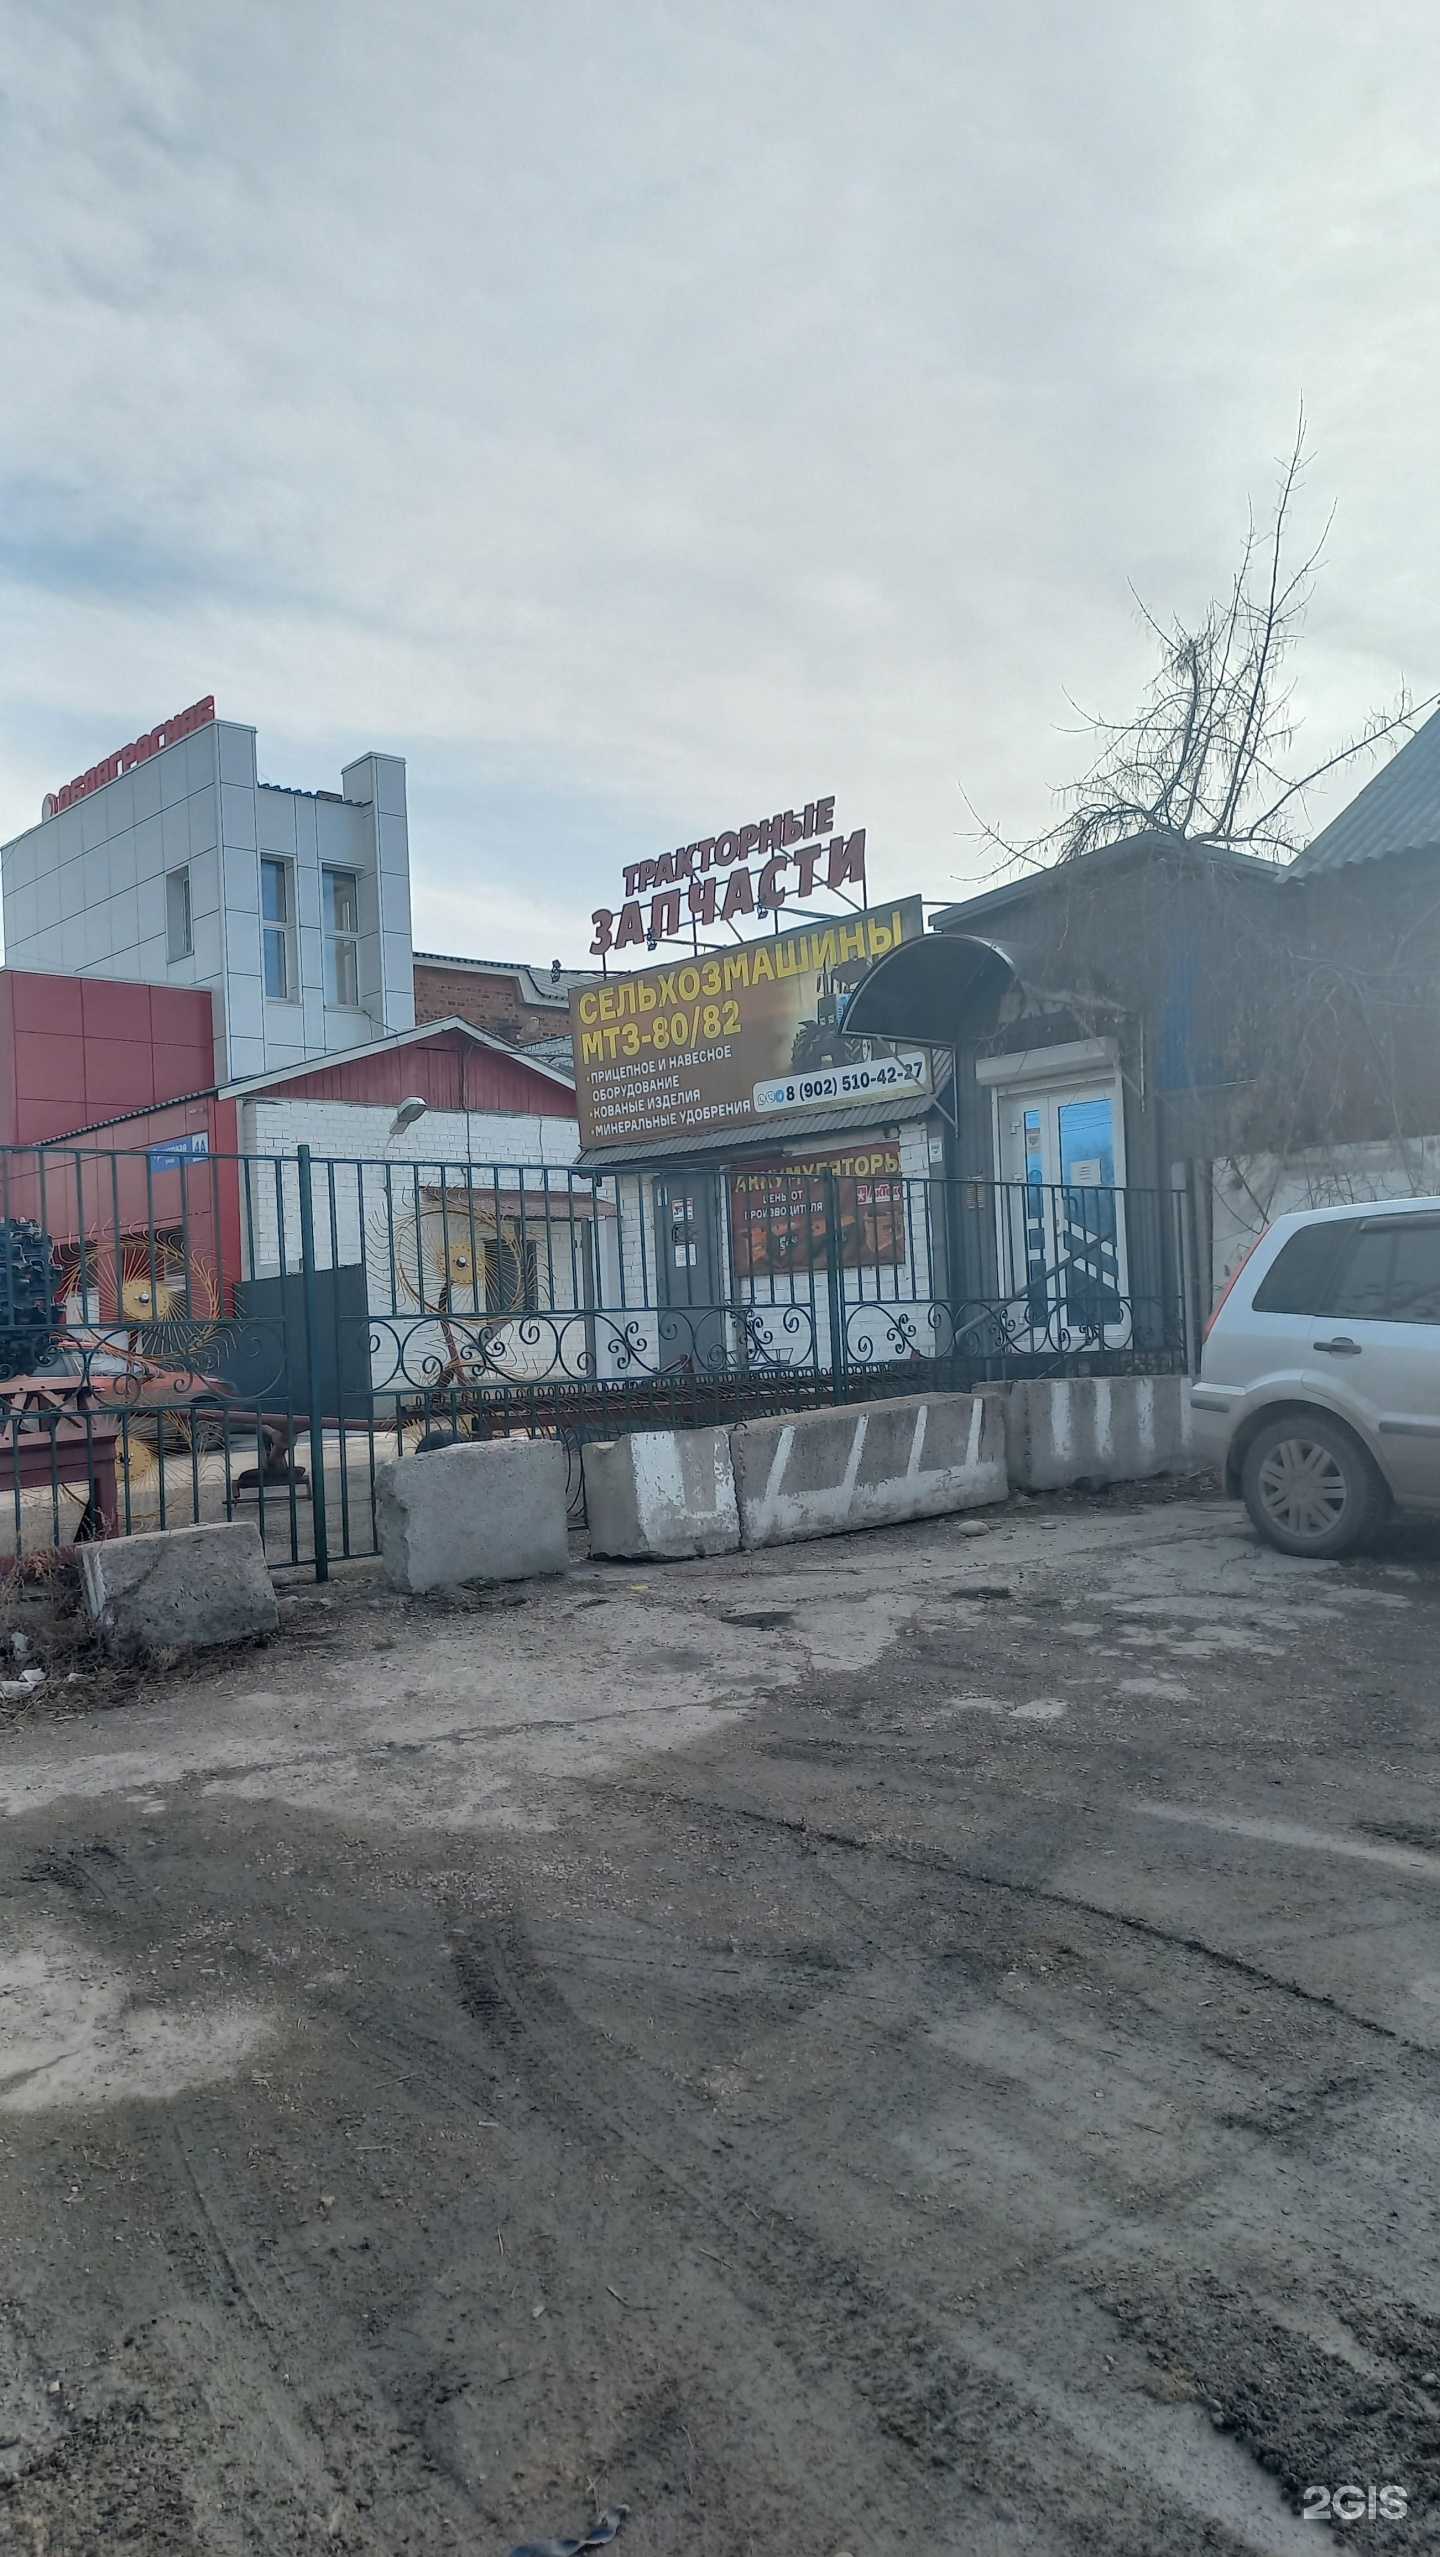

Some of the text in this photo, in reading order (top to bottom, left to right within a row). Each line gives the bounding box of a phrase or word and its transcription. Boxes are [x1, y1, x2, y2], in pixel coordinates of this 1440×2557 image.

[622, 795, 835, 897] ТРАКТОРНЫЕ
[589, 828, 867, 955] ЗАПЧАСТИ
[578, 910, 904, 1026] СЕЛЬХОЗМАШИНЫ
[580, 999, 742, 1065] МТЗ-80/82
[590, 1045, 732, 1085] ПРИЦЕПНОЕ И НАВЕСНОЕ
[785, 1061, 924, 1101] 8 (902) 510-42-27
[592, 1075, 680, 1102] ОБОРУДОВАНИЕ
[592, 1089, 701, 1120] КОВАНЫЕ ИЗДЕЛИЯ
[594, 1099, 751, 1137] МИНЕРАЛЬНЫЕ УДОБРЕНИЯ
[791, 1189, 804, 1201] ОТ
